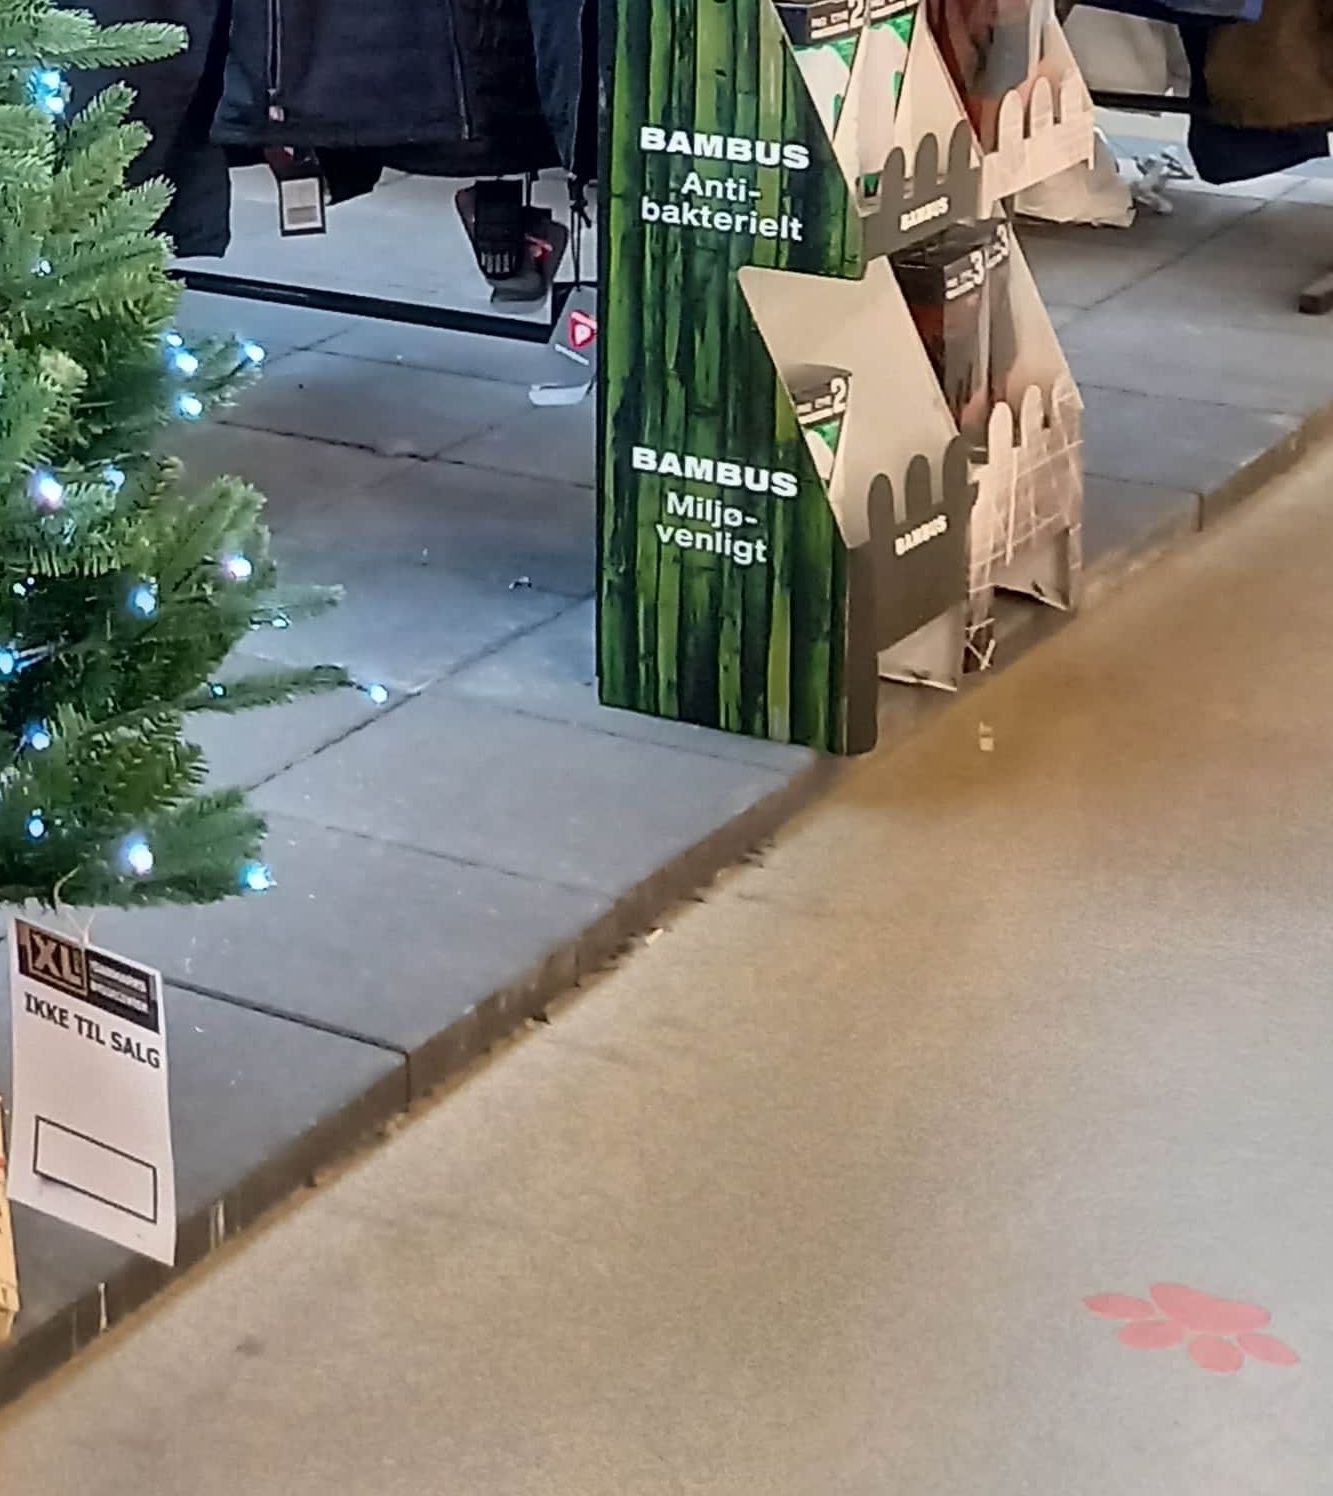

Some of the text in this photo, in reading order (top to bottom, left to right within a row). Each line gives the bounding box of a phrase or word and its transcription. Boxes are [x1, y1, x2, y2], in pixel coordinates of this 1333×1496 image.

[640, 126, 811, 170] BAMBUS
[681, 171, 763, 203] Anti-
[641, 195, 804, 242] bakterielt
[632, 446, 800, 498] BAMBUS
[667, 490, 759, 529] Miljø-
[655, 523, 768, 566] venligt
[32, 933, 83, 985] XL
[24, 990, 161, 1069] IKKE TIL SALG
